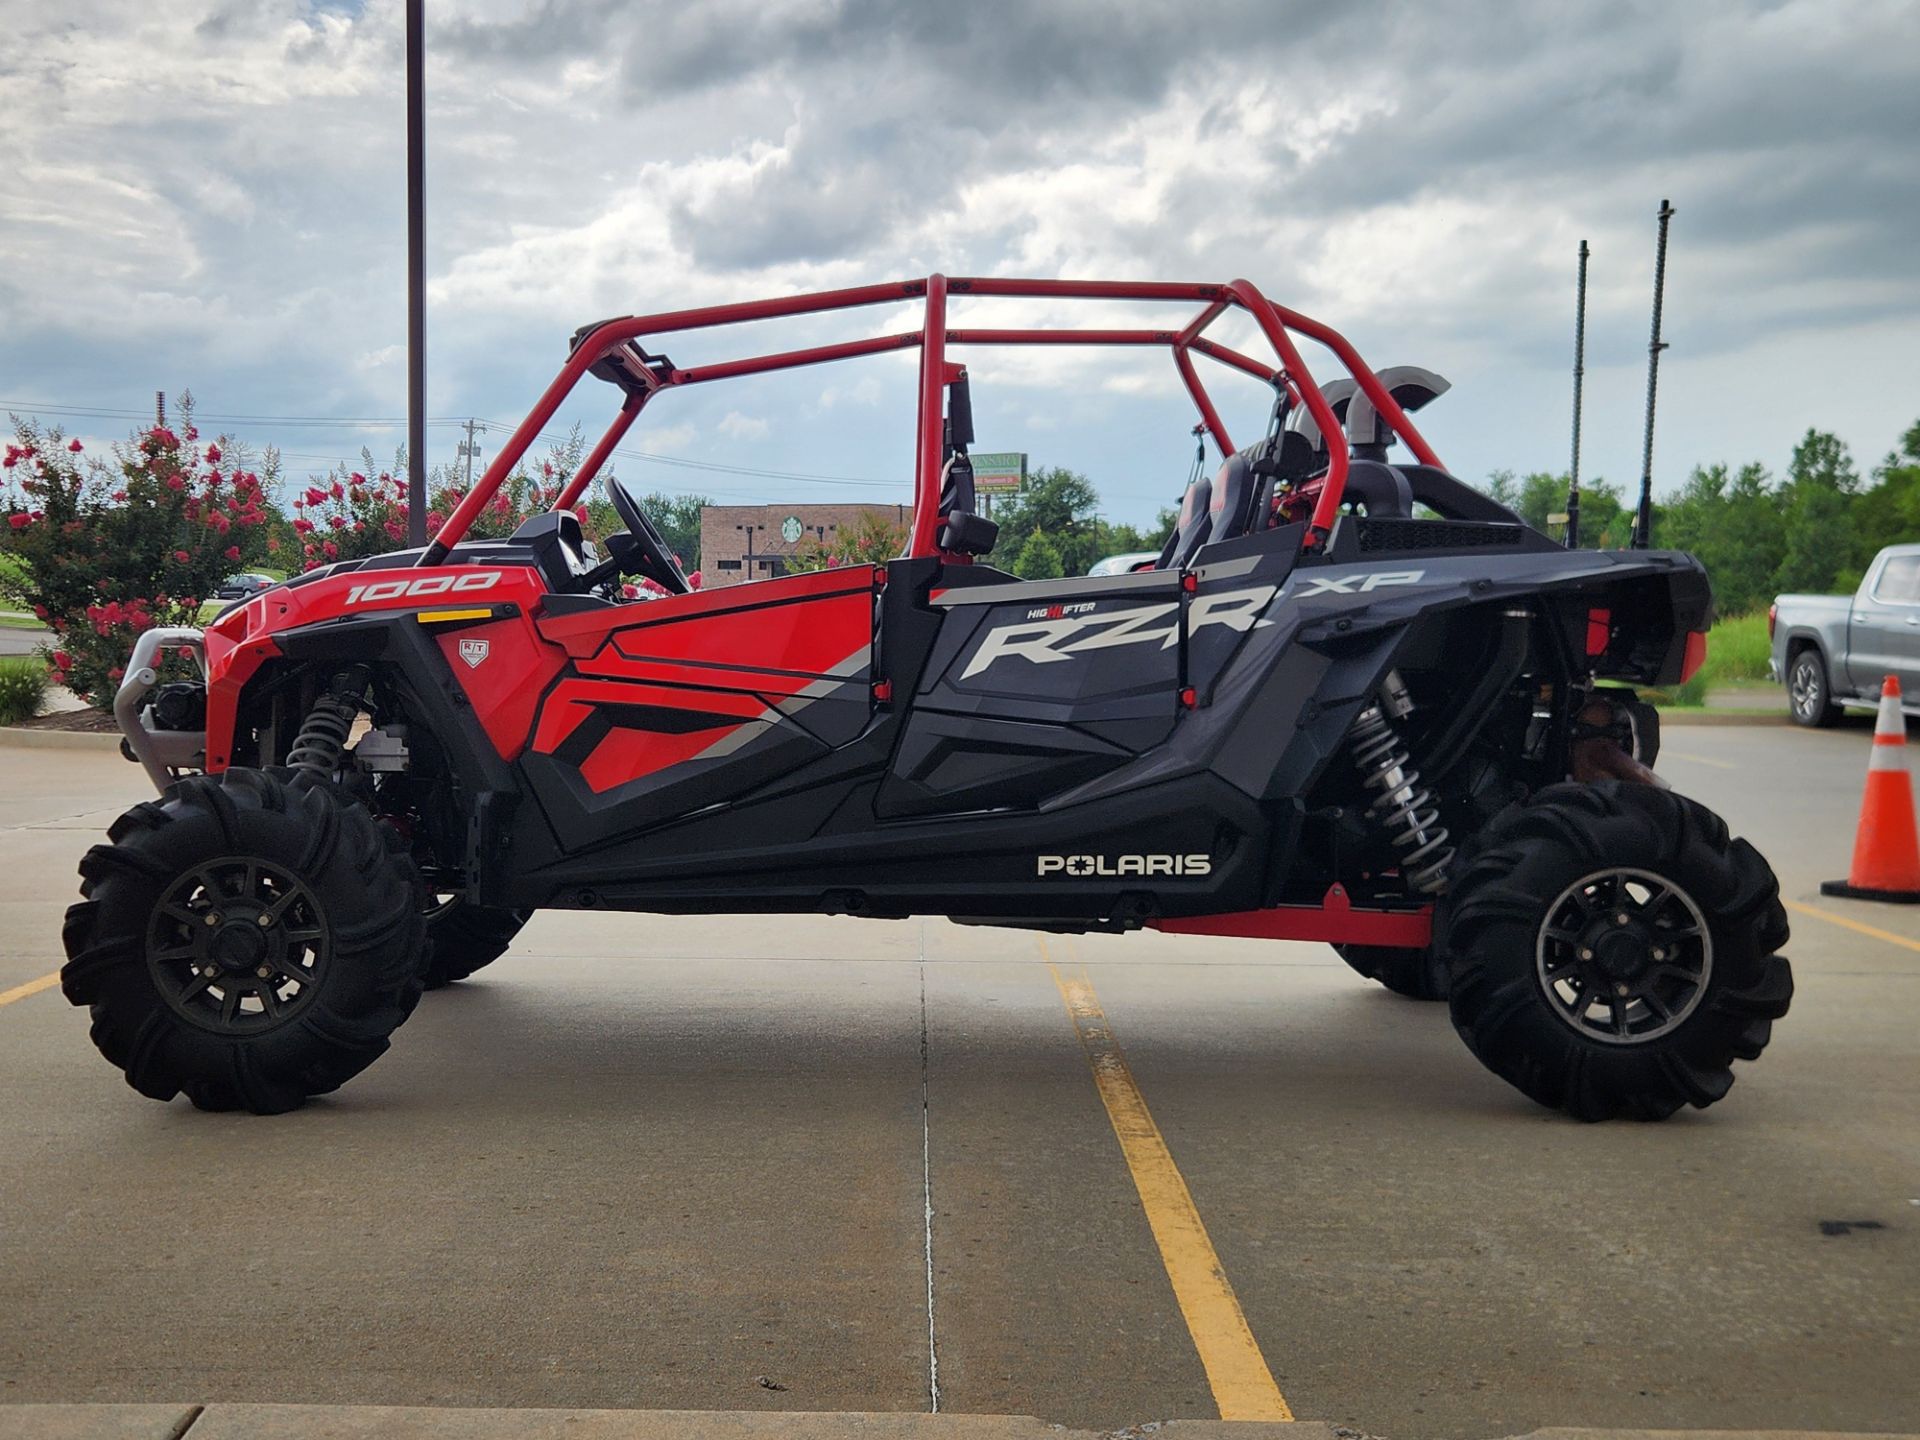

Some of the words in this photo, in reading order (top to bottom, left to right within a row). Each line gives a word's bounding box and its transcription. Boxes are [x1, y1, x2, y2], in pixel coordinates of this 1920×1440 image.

[345, 572, 501, 605] 1000
[1293, 569, 1425, 597] XP
[959, 585, 1284, 681] RZR
[1038, 854, 1211, 876] POLARIS
